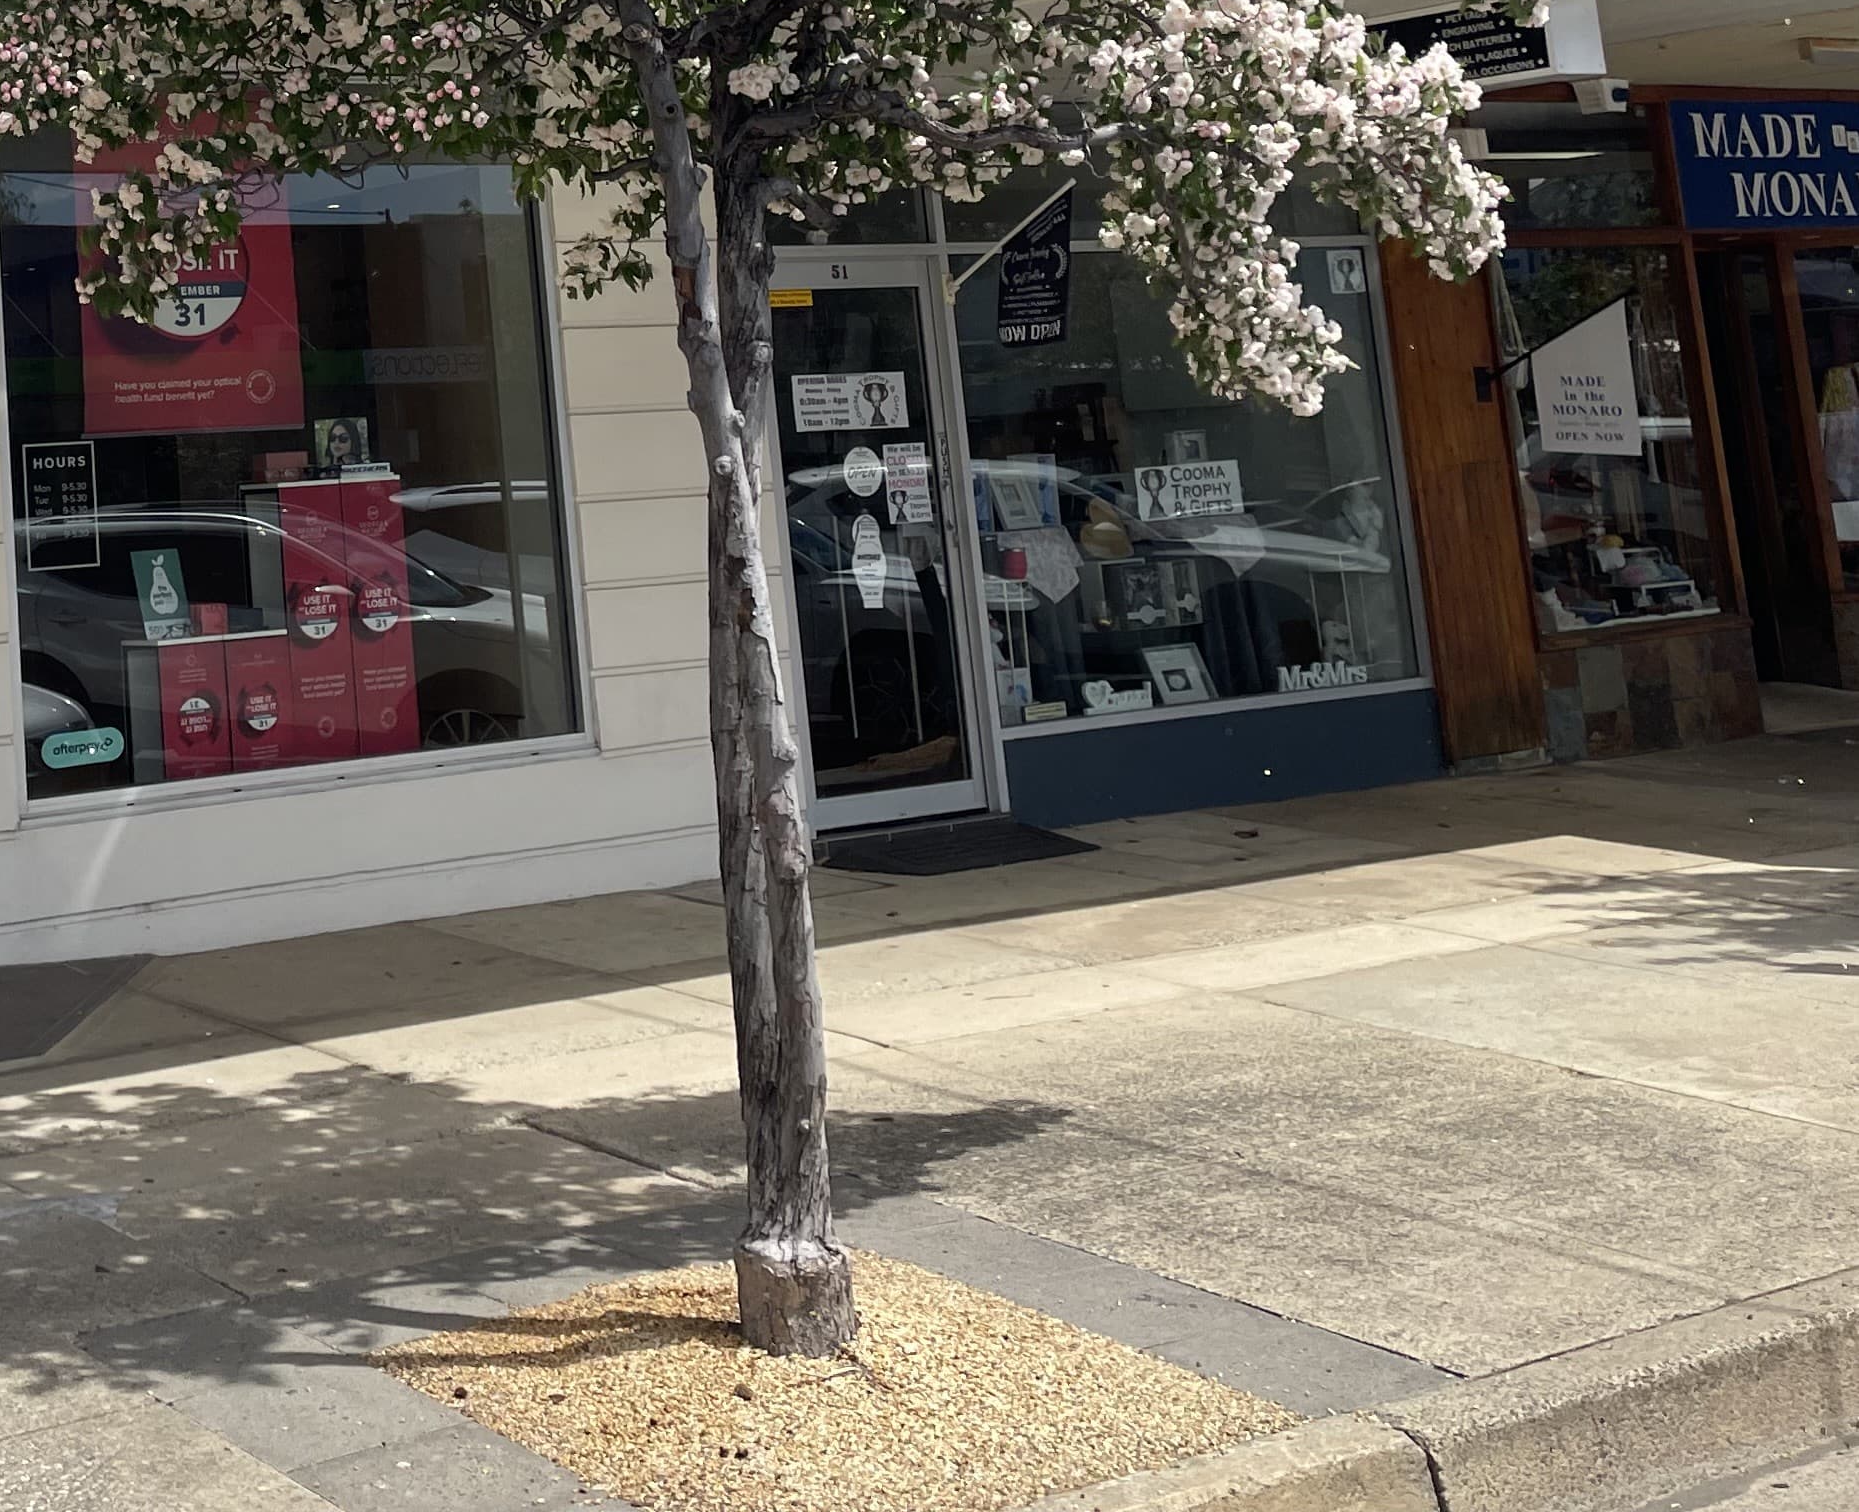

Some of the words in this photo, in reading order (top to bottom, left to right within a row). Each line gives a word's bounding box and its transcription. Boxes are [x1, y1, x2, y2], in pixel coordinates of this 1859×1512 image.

[1445, 12, 1462, 24] PET
[1442, 21, 1495, 37] ENGRAVING
[1463, 33, 1512, 50] BATTERIES
[1476, 47, 1519, 62] PLAQUES
[1481, 59, 1535, 76] OCCASIONS
[1688, 112, 1821, 158] MADE
[1730, 171, 1859, 217] MONA
[219, 249, 239, 270] IT
[831, 264, 848, 279] 51
[175, 303, 206, 327] 31
[139, 381, 157, 394] you
[1560, 376, 1606, 387] MADE
[1565, 390, 1577, 401] in
[1585, 391, 1605, 401] the
[1552, 404, 1622, 416] MONARO
[1556, 432, 1589, 441] OPEN
[1595, 432, 1624, 441] NOW
[33, 456, 87, 470] HOURS
[848, 466, 878, 479] OPEN
[1170, 466, 1226, 482] COOMA
[33, 484, 52, 493] Mon
[1172, 483, 1231, 499] TROPHY
[34, 496, 50, 505] Tue
[1189, 499, 1234, 516] GIFTS
[365, 589, 381, 598] USE
[384, 587, 392, 597] IT
[304, 595, 320, 605] USE
[323, 594, 331, 604] IT
[367, 598, 386, 608] LOSE
[390, 597, 398, 606] IT
[305, 606, 327, 615] LOSE
[329, 604, 337, 614] IT
[375, 618, 387, 628] 31
[314, 625, 326, 635] 31
[1277, 660, 1367, 693] Mr&Mrs
